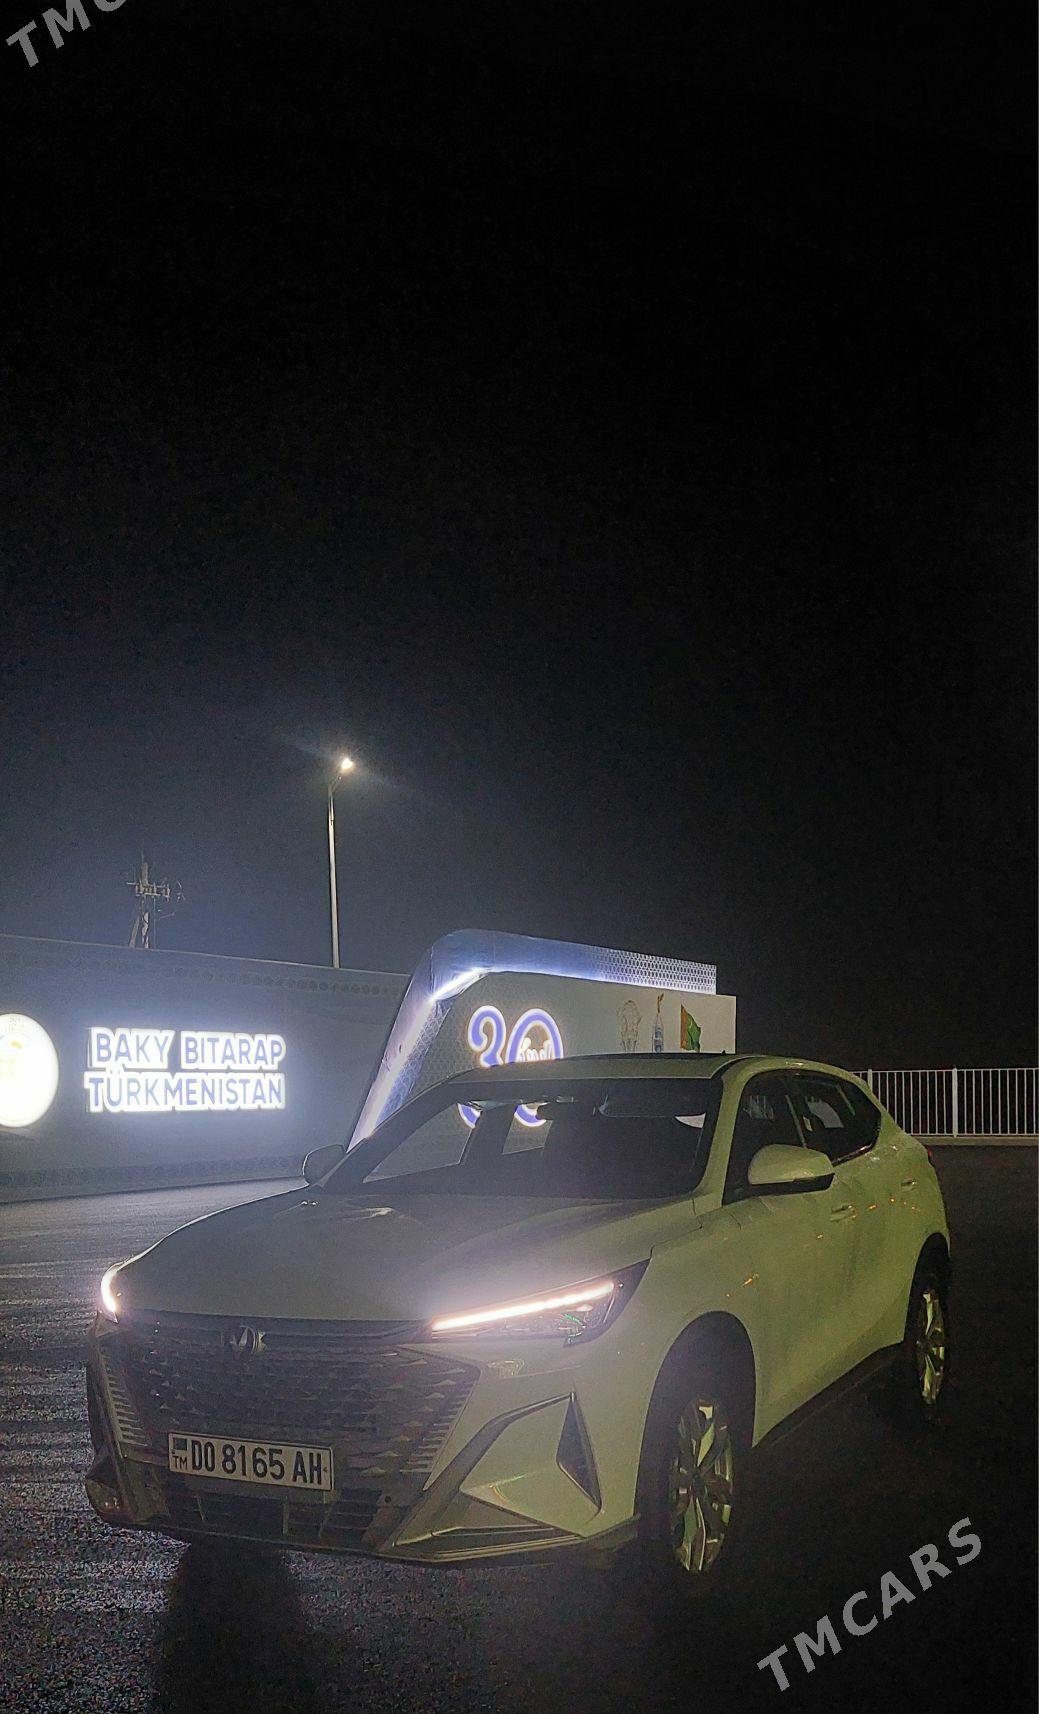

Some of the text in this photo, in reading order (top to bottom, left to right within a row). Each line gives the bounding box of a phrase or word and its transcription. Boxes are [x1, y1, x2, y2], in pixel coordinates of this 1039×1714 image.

[94, 1030, 284, 1067] BAKY BITARAP
[87, 1069, 283, 1108] TÜRKMENISTAN
[173, 1455, 188, 1471] TM
[292, 1451, 322, 1485] AH
